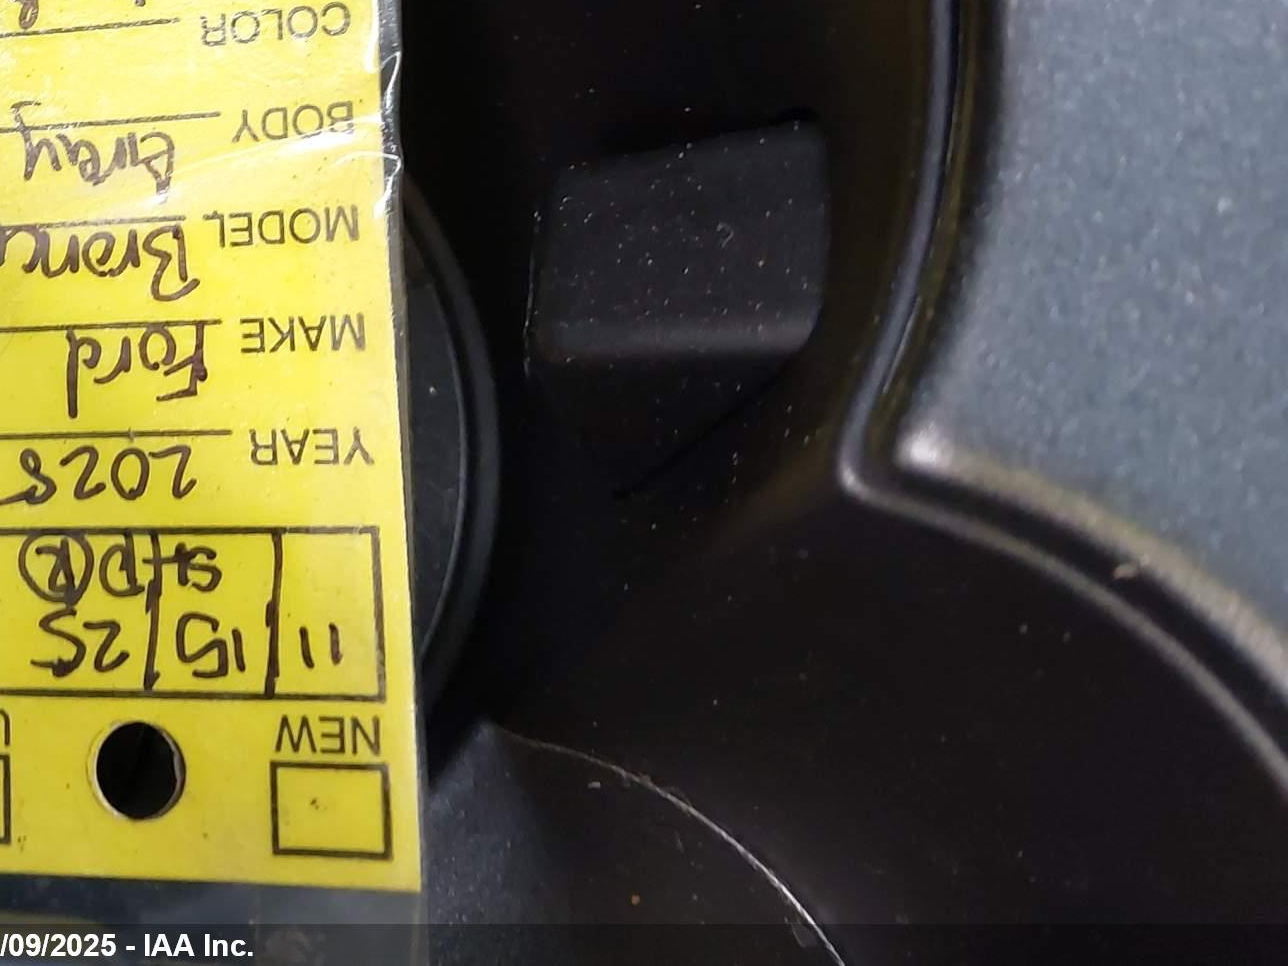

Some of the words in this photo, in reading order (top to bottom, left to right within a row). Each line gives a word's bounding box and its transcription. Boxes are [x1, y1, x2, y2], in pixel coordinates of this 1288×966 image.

[201, 2, 351, 46] COLOR
[231, 100, 355, 143] BODY
[11, 100, 175, 195] Gray
[204, 205, 360, 247] MODEL
[241, 313, 367, 353] MAKE
[67, 321, 207, 418] Ford
[250, 428, 375, 466] YEAR
[276, 715, 381, 756] NEW
